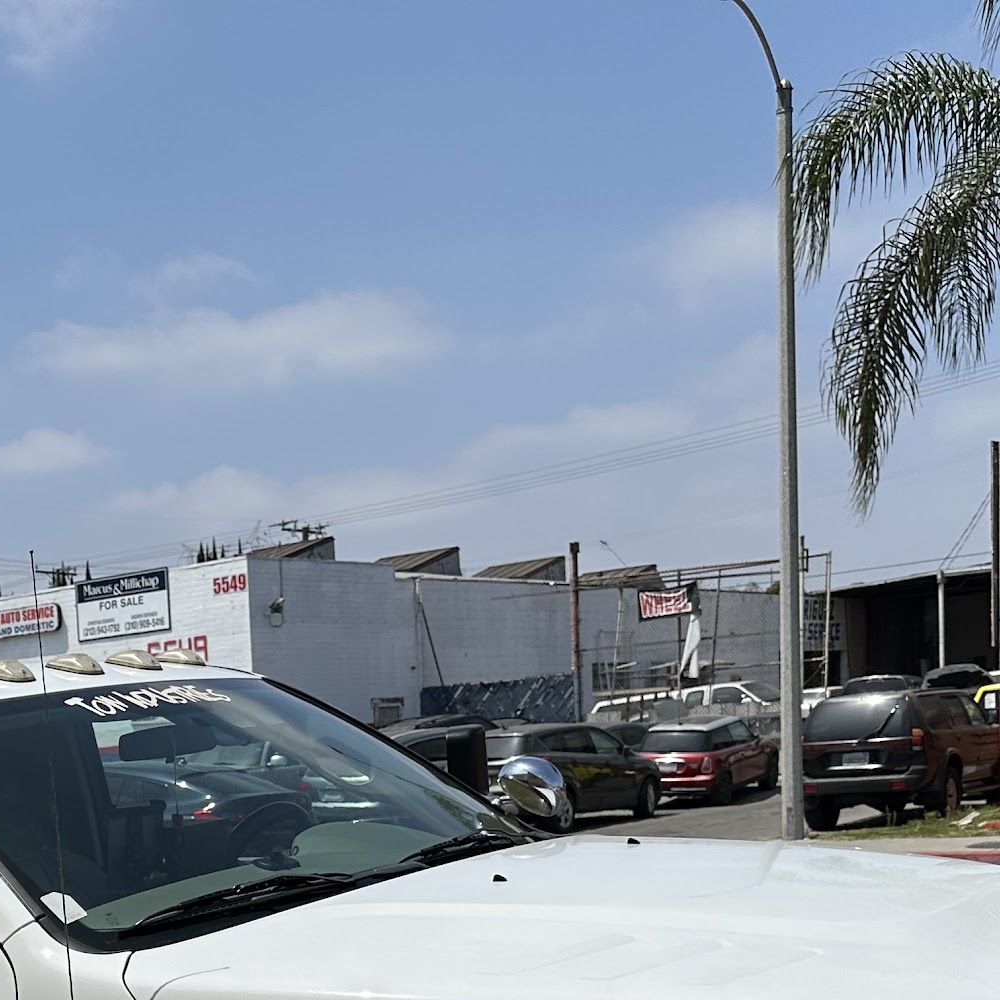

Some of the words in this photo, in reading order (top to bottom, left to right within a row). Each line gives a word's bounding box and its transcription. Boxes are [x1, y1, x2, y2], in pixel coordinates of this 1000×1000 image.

[82, 584, 113, 597] Marcus
[113, 583, 122, 595] &
[120, 576, 160, 591] Millichap
[213, 573, 246, 594] 5549
[99, 599, 118, 611] FOR
[120, 595, 144, 607] SALE
[0, 610, 20, 624] AUTO
[22, 605, 54, 621] SERVICE
[64, 691, 129, 717] TOW
